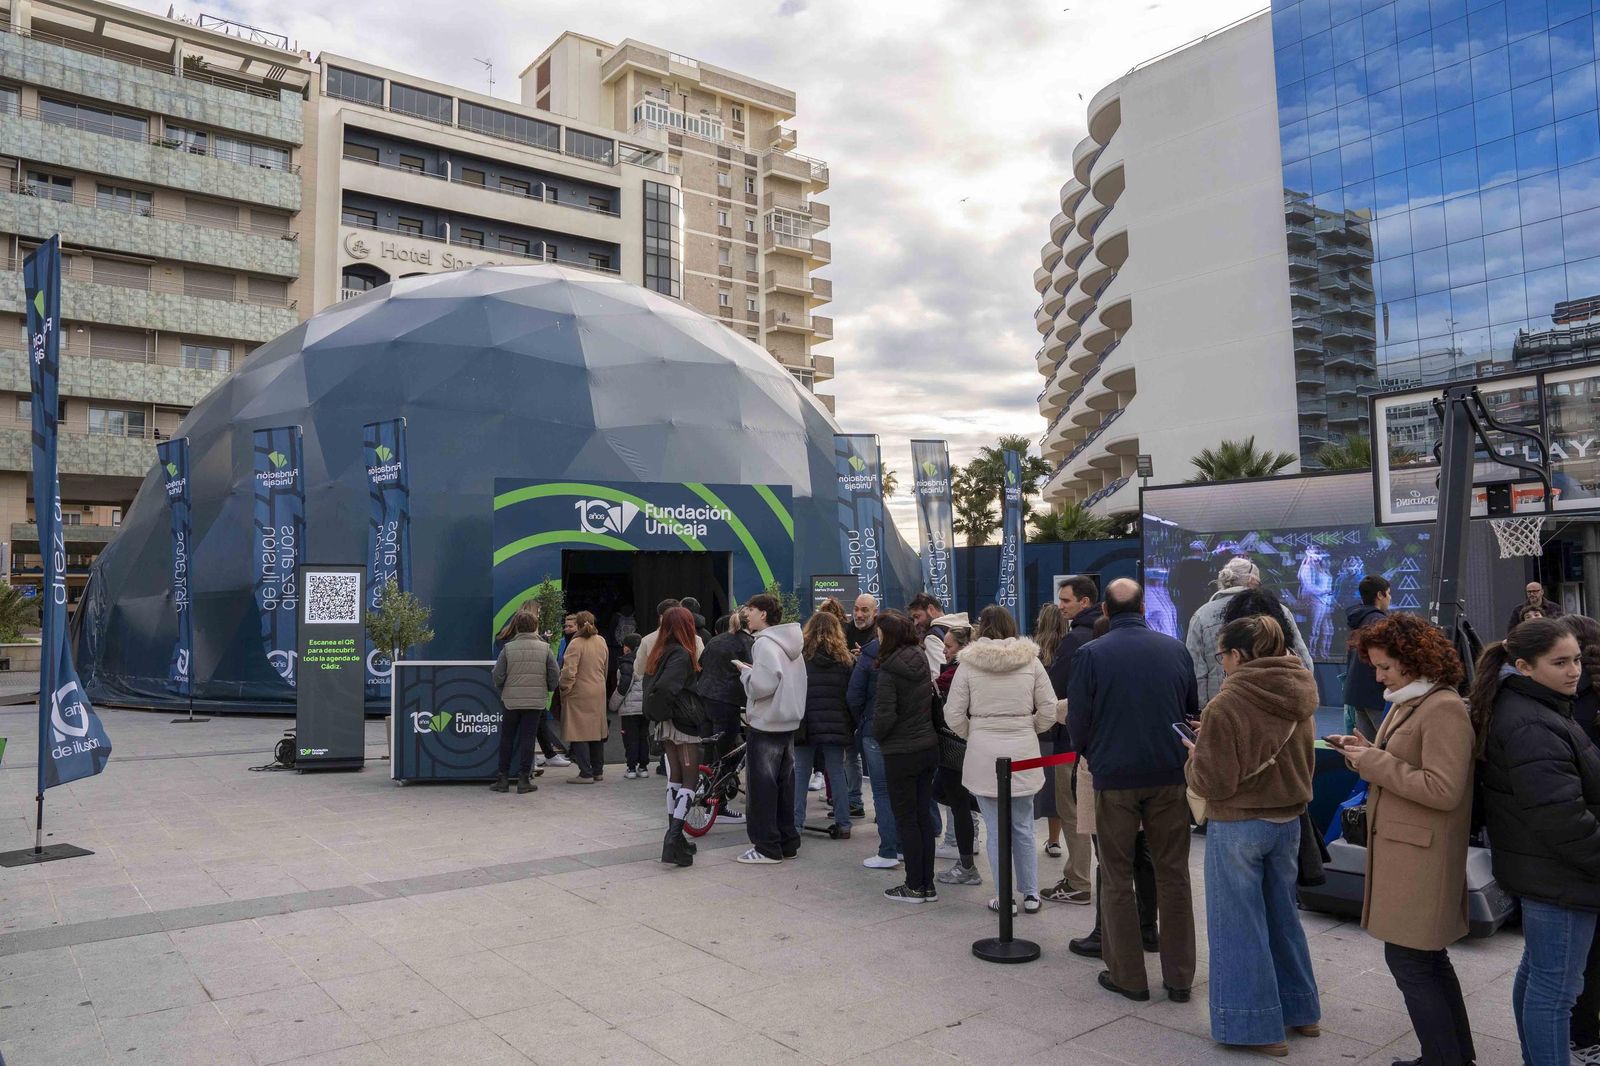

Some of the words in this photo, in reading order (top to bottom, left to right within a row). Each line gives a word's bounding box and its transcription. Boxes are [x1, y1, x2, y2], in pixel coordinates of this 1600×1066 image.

[380, 240, 432, 266] Hotel
[1499, 438, 1600, 463] PLAY
[588, 512, 605, 520] años
[645, 503, 732, 521] Fundación
[645, 519, 708, 540] Unicaja
[455, 712, 504, 723] Fundaci
[455, 722, 498, 736] Unicaja
[52, 745, 72, 760] de
